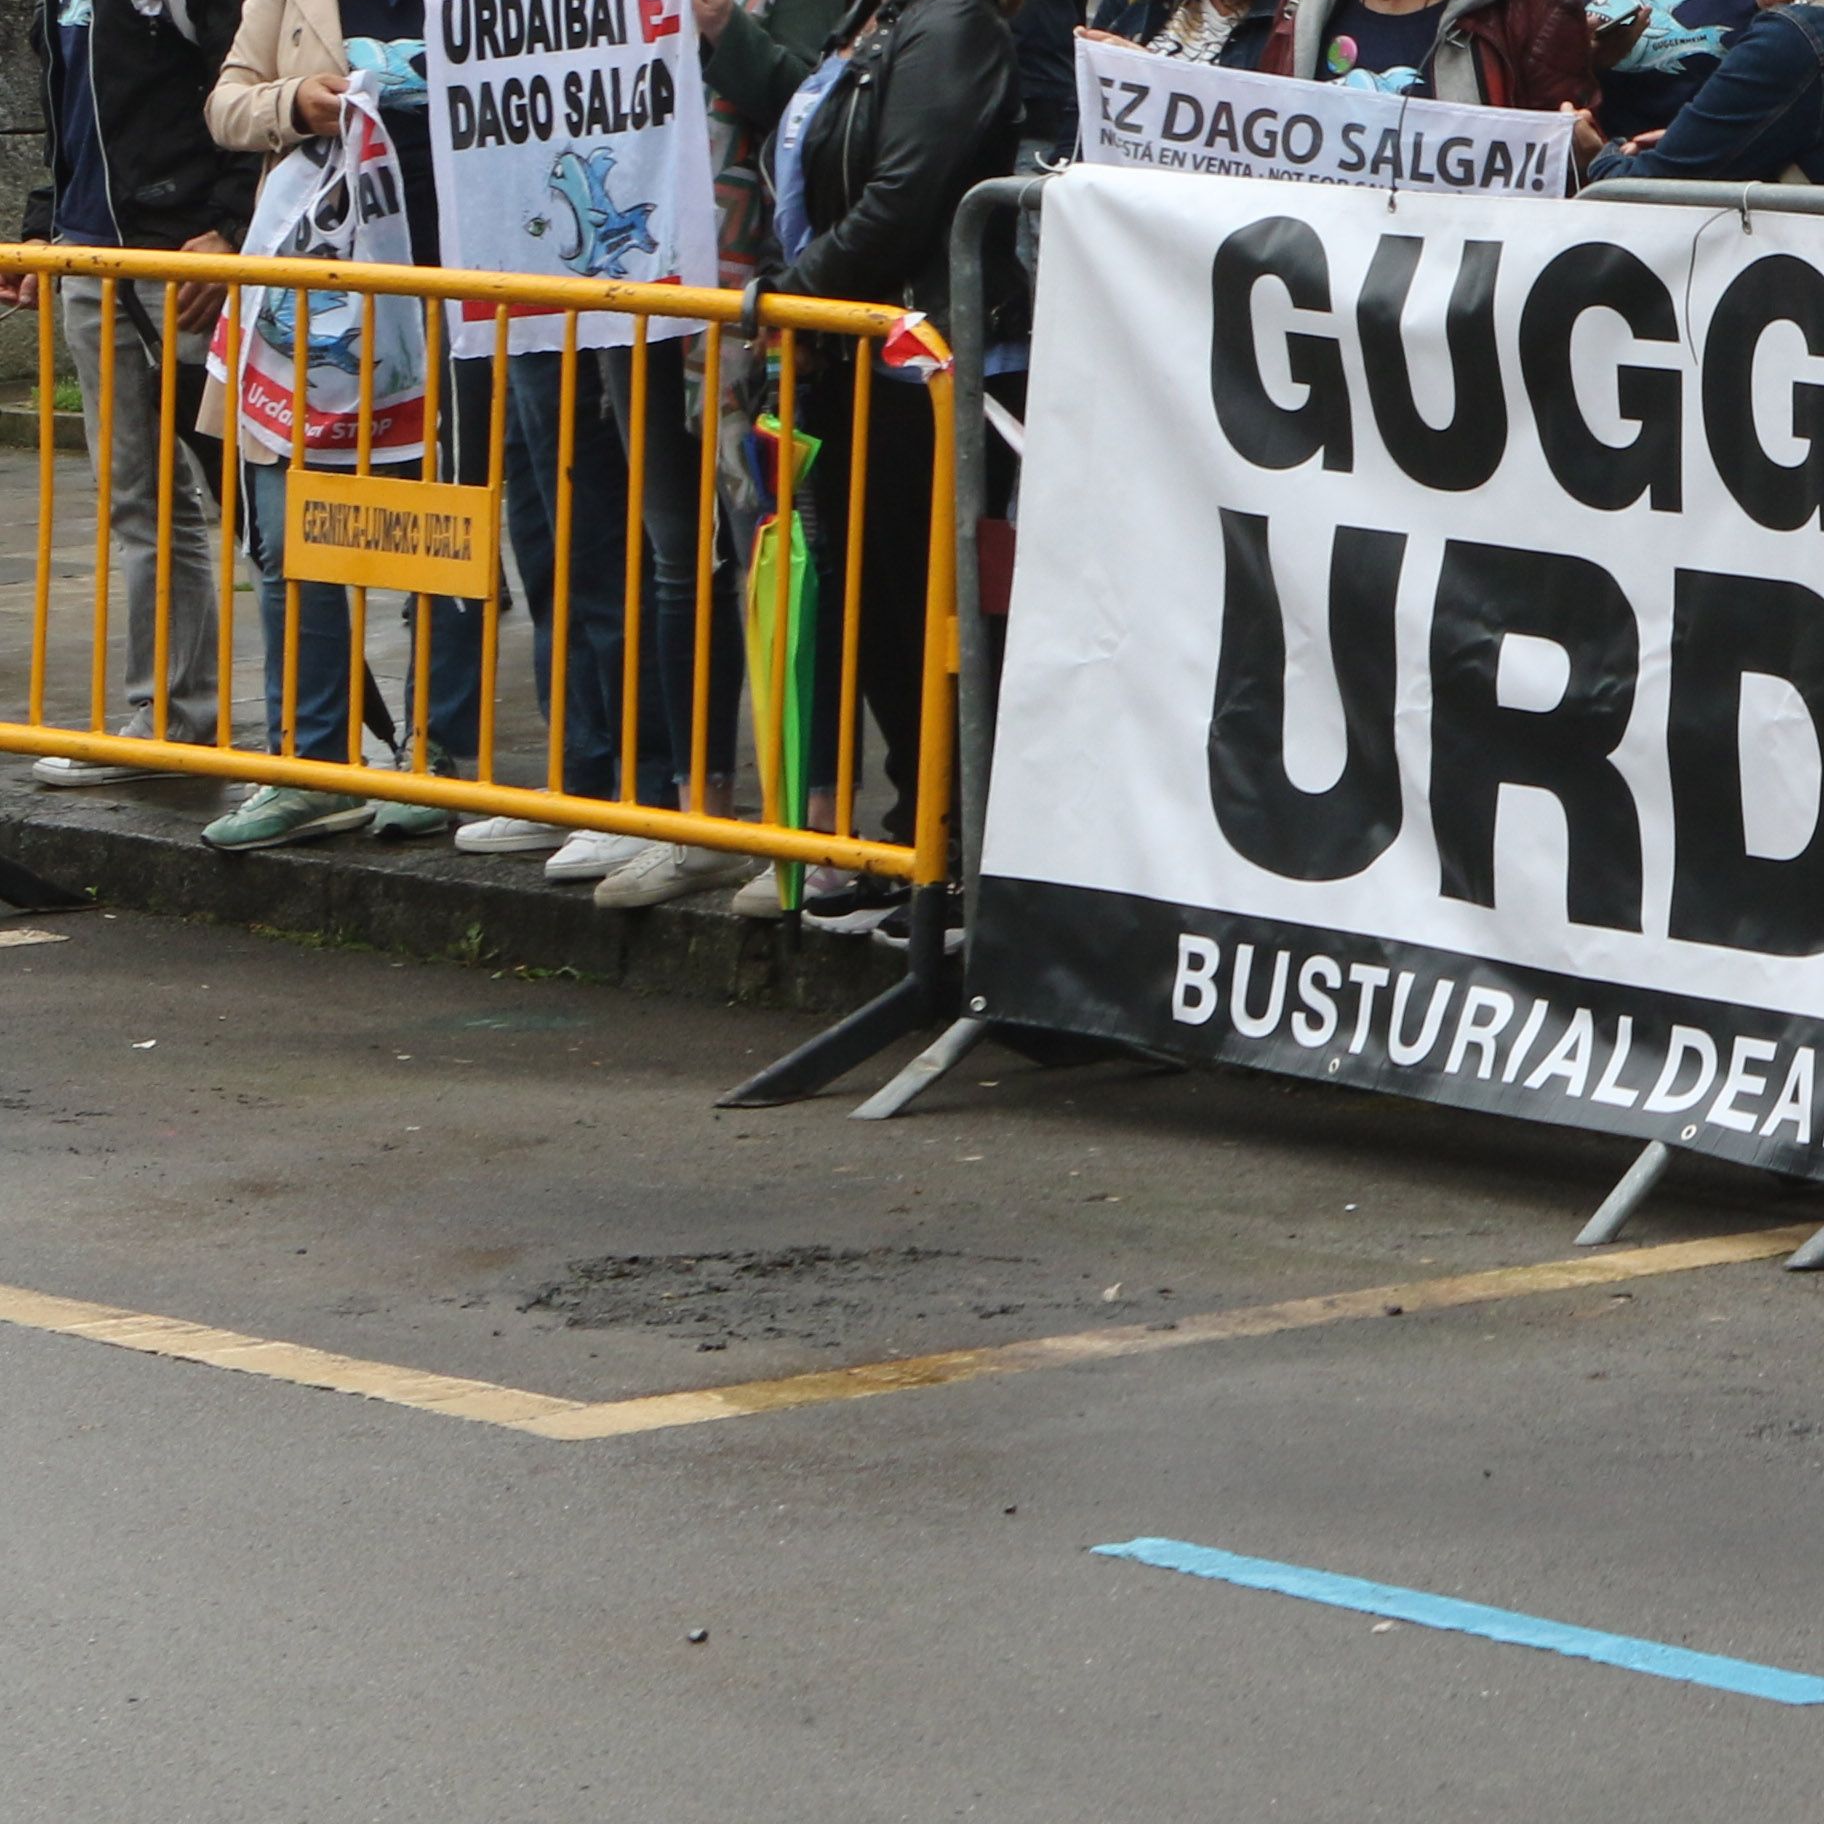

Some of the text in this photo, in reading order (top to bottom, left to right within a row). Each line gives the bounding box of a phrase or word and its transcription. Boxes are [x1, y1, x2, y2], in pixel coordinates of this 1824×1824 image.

[447, 58, 676, 152] DAGO SALGA
[1161, 92, 1324, 165] DAGO
[1159, 147, 1187, 169] EN
[1191, 153, 1253, 178] VENTA
[425, 512, 472, 561] UDALA
